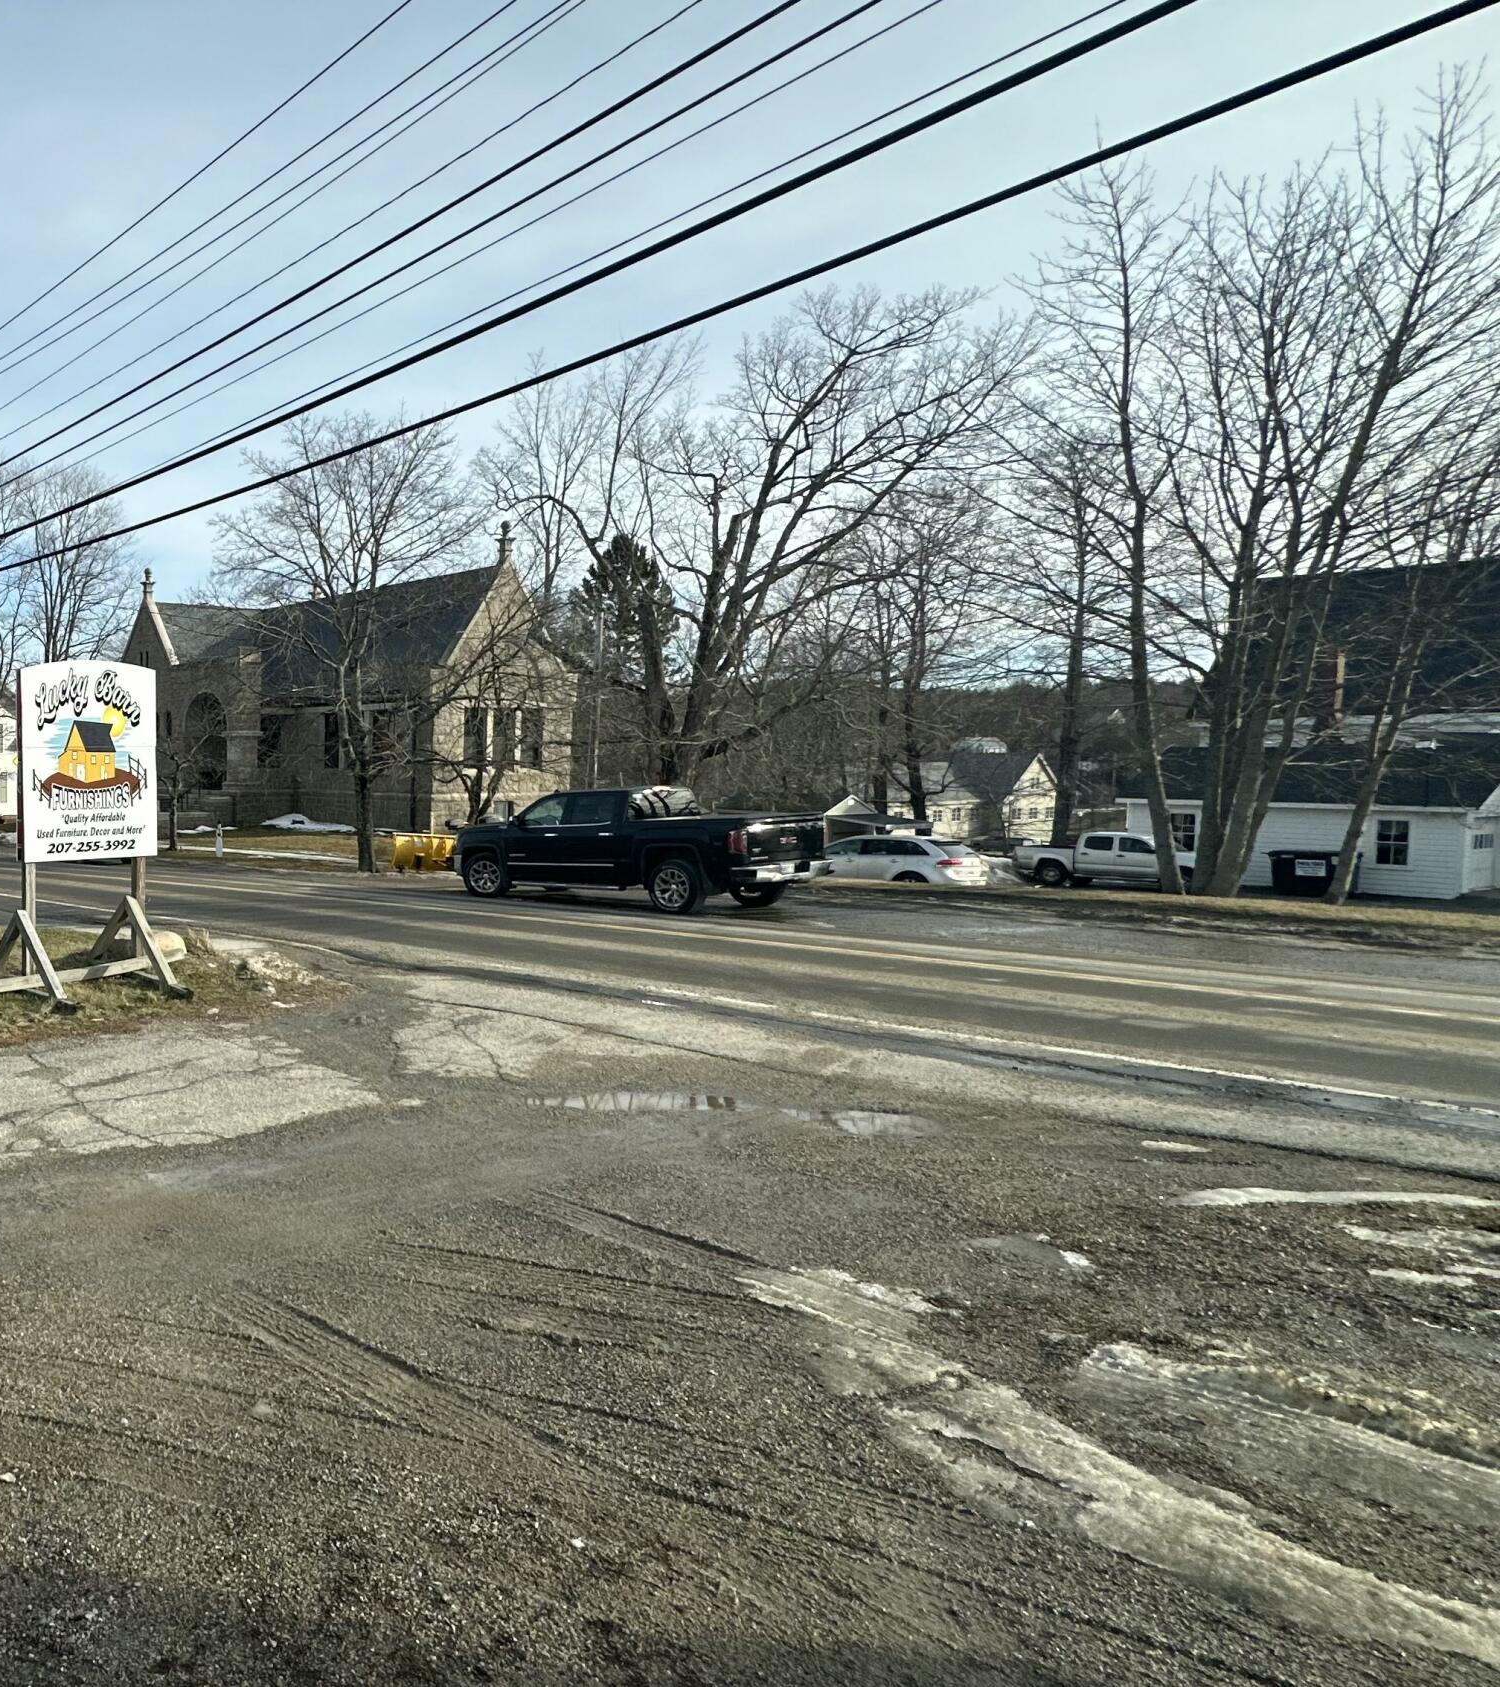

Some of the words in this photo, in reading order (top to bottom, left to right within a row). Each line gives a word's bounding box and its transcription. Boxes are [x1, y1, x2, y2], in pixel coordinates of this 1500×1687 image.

[35, 668, 89, 731] Lucky
[94, 670, 141, 727] Barn
[52, 782, 130, 810] FURNISHINGS
[90, 812, 126, 822] Affordable
[36, 828, 54, 839] Used
[90, 827, 110, 836] Decor
[111, 826, 125, 835] and
[46, 839, 136, 854] 207-255-3992
